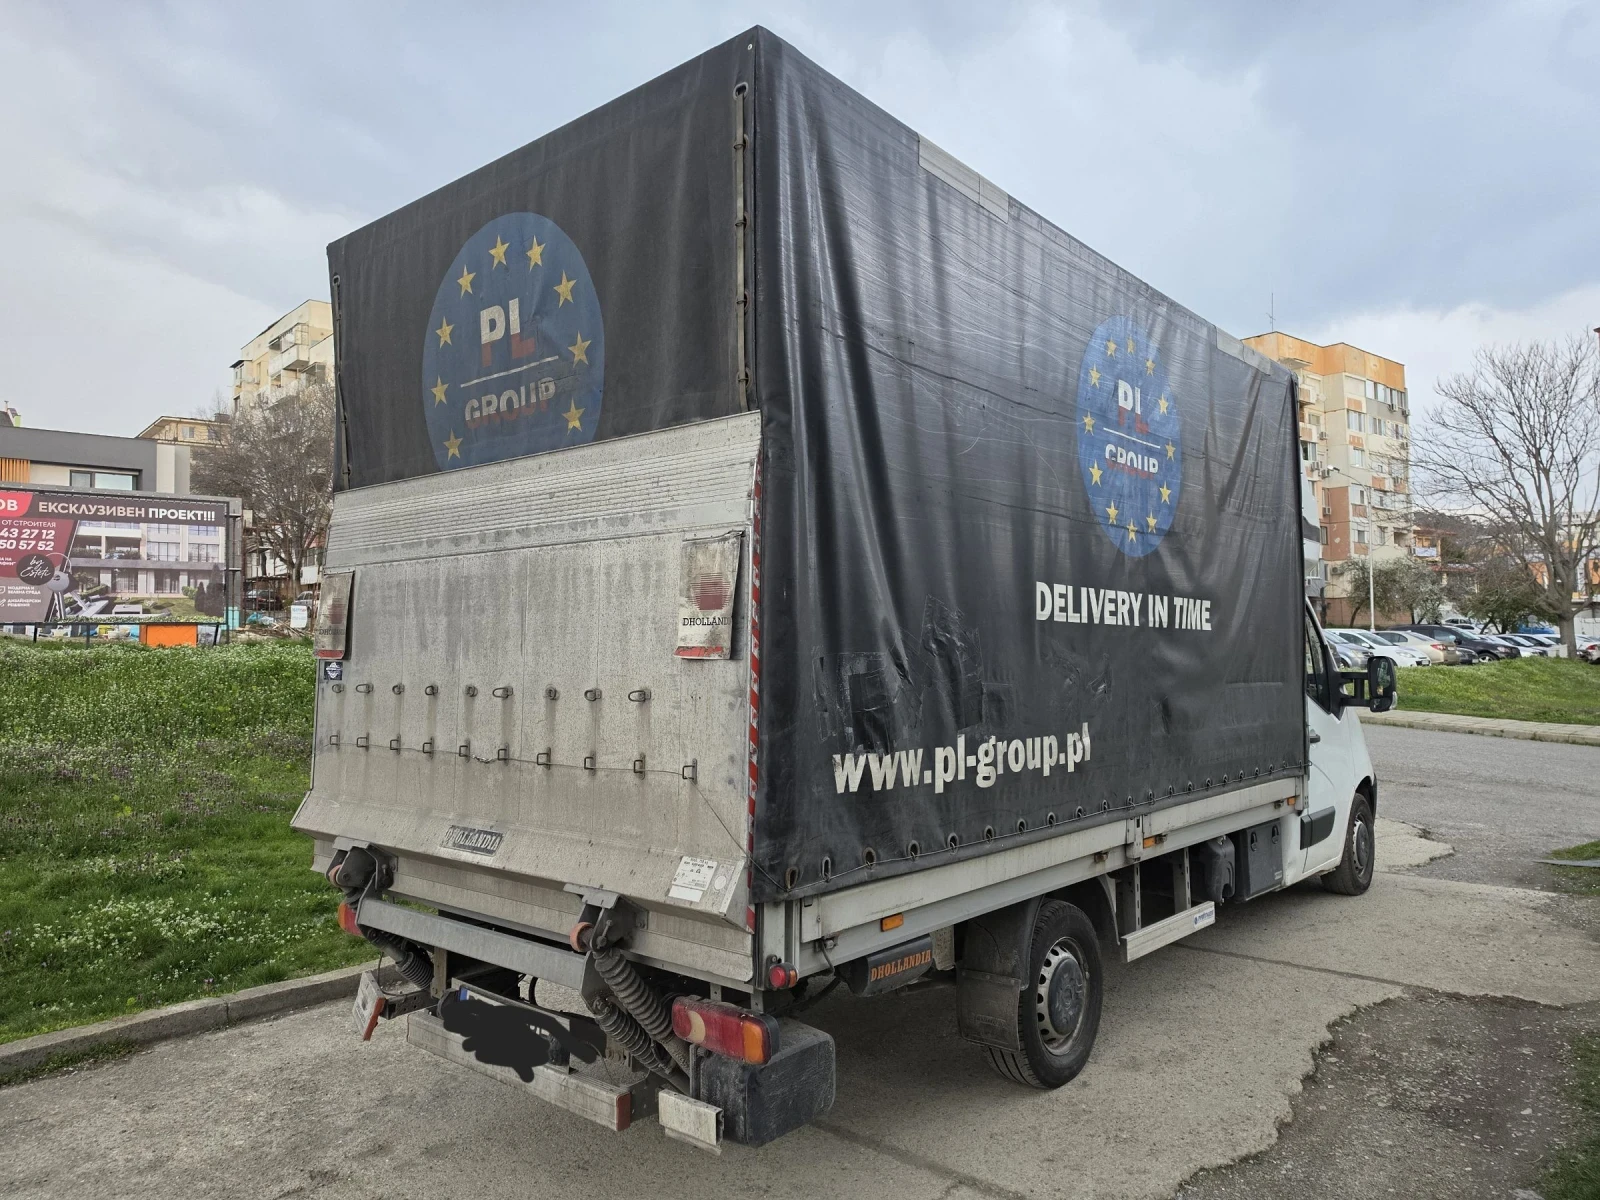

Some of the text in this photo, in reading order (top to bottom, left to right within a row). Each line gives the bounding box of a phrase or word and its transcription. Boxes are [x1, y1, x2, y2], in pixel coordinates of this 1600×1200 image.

[480, 298, 536, 368] PL
[464, 376, 557, 430] GROUP
[1118, 379, 1150, 434] PL
[1105, 443, 1159, 480] GROUP
[13, 520, 56, 528] СТРОИТЕЛЯ
[38, 501, 216, 522] ЕКСКЛУЗИВЕН ПРОЕКТ!!!
[18, 540, 36, 551] 57
[37, 540, 55, 551] 52
[20, 529, 39, 539] 27
[41, 529, 56, 540] 12
[1036, 581, 1212, 631] DELIVERY IN TIME
[832, 722, 1091, 794] www.pl-group.pl
[870, 949, 931, 982] DHOLLANDIA
